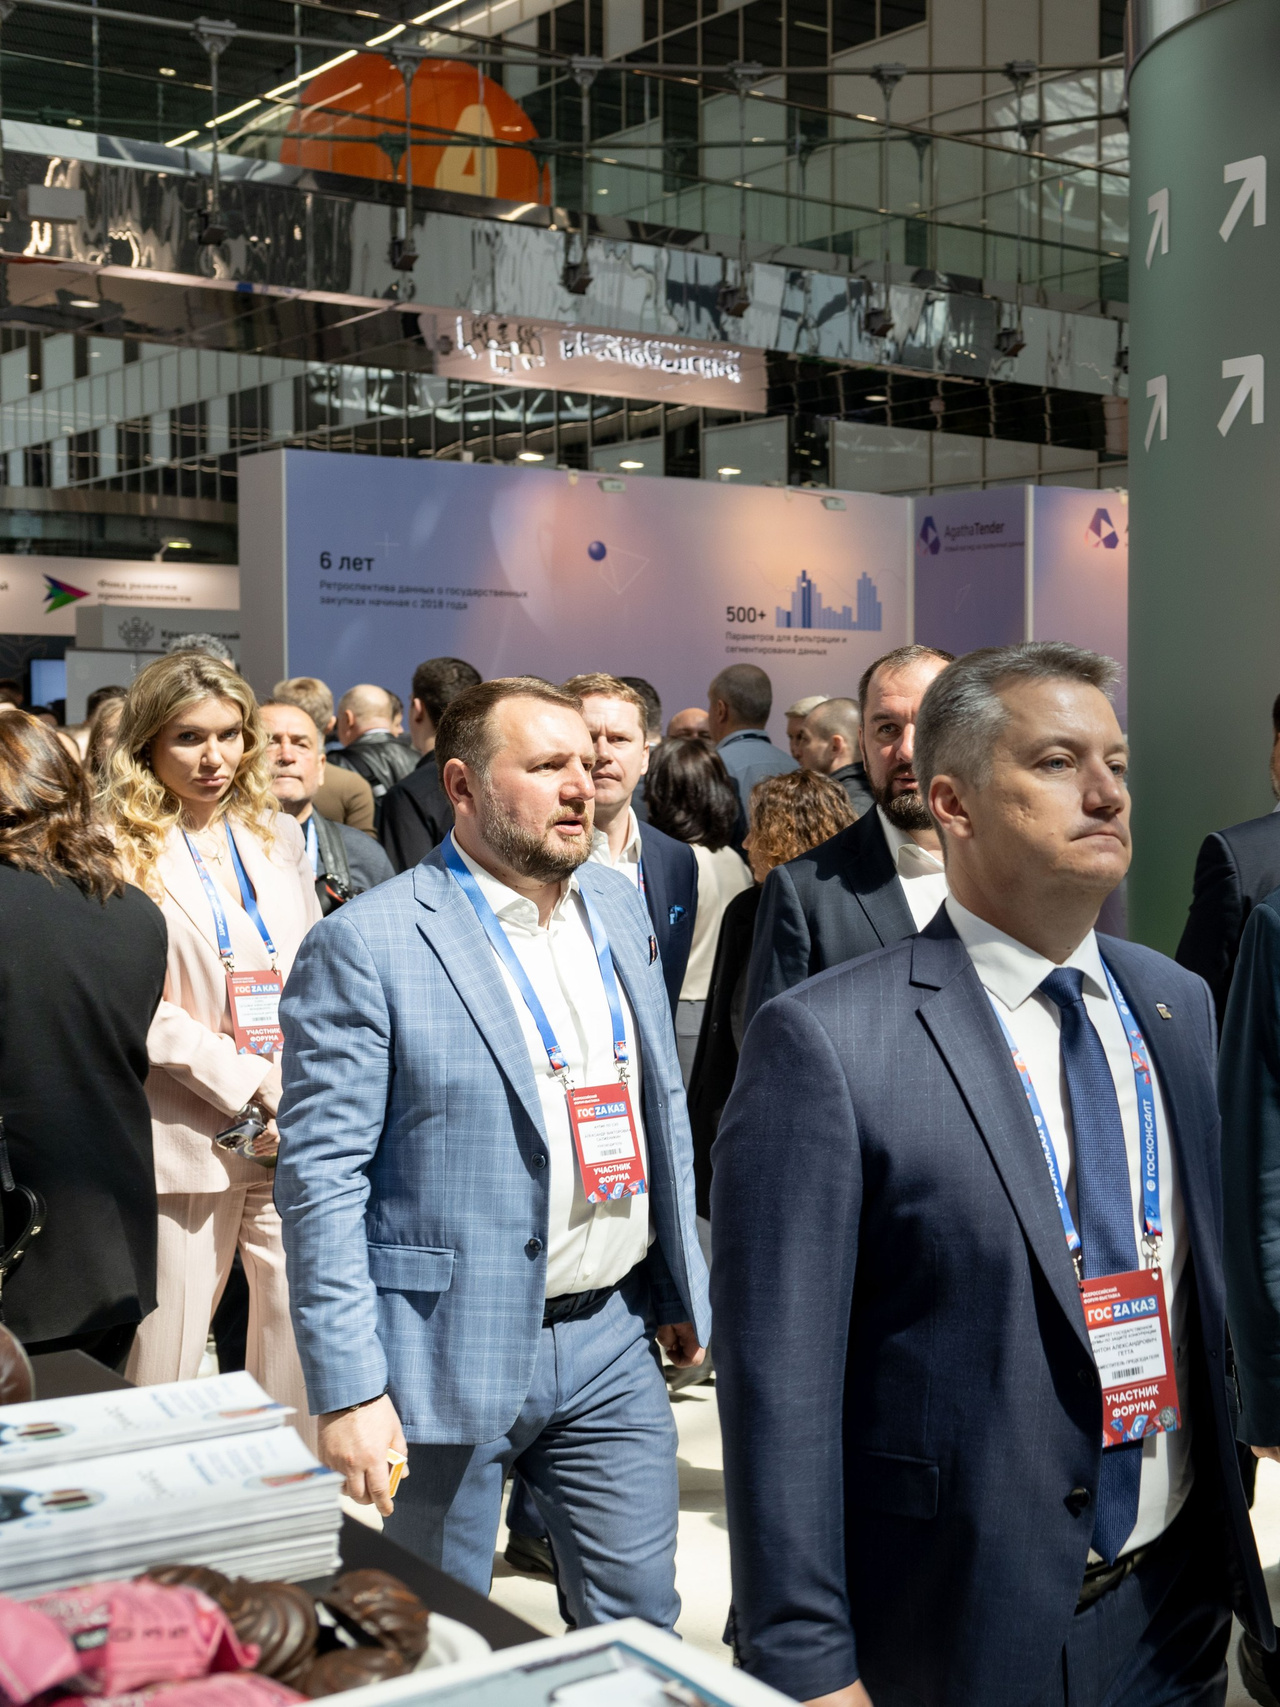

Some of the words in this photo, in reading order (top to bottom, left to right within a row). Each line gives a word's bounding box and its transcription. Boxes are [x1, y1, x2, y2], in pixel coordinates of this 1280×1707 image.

[319, 551, 332, 571] 6
[338, 556, 375, 572] лет
[319, 580, 396, 593] Ретроспектива
[726, 605, 767, 623] 500+
[725, 631, 774, 642] Параметров
[793, 633, 841, 644] фильтрации
[1142, 1099, 1156, 1177] ГОСКОНСАЛТ
[593, 1162, 632, 1176] УЧАСТНИК
[598, 1172, 631, 1184] ФОРУМА
[1112, 1338, 1157, 1350] АЛЕКСАНДРОВИЧ
[1117, 1349, 1134, 1357] ГЕТТА
[1106, 1384, 1159, 1406] УЧАСТНИК
[1112, 1399, 1156, 1419] ФОРУМА
